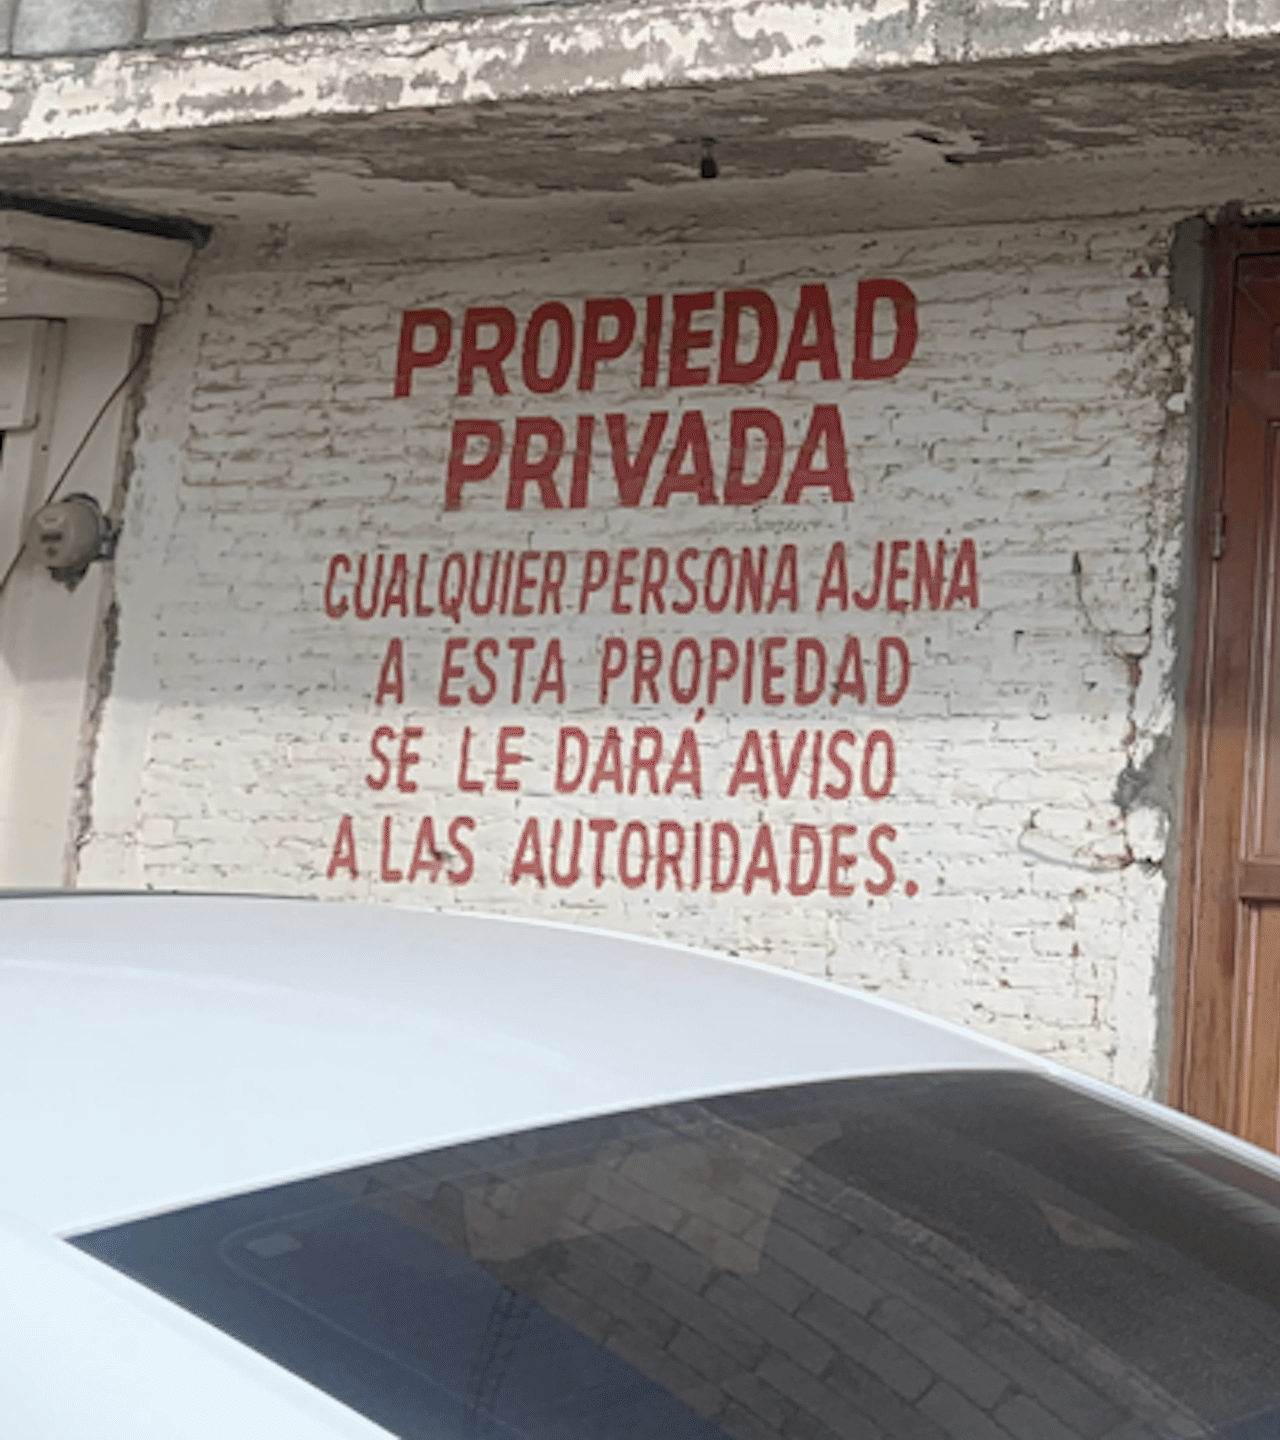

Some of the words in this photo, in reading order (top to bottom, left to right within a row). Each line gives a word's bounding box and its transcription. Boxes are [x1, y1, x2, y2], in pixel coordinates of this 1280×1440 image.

[392, 278, 920, 399] PROPIEDAD
[443, 403, 856, 512] PRIVADA
[323, 549, 567, 624] CUALQUIER
[578, 543, 800, 616] PERSONA
[815, 536, 980, 613] AJENA
[373, 636, 405, 707] A
[436, 636, 568, 708] ESTA
[598, 634, 914, 708] PROPIEDAD
[364, 723, 426, 795] SE
[456, 724, 527, 796] LE
[553, 705, 706, 799] DARÁ
[725, 728, 898, 803] AVISO
[324, 814, 362, 883] A
[379, 814, 478, 887] LAS
[507, 815, 920, 899] AUTORIDADES.
